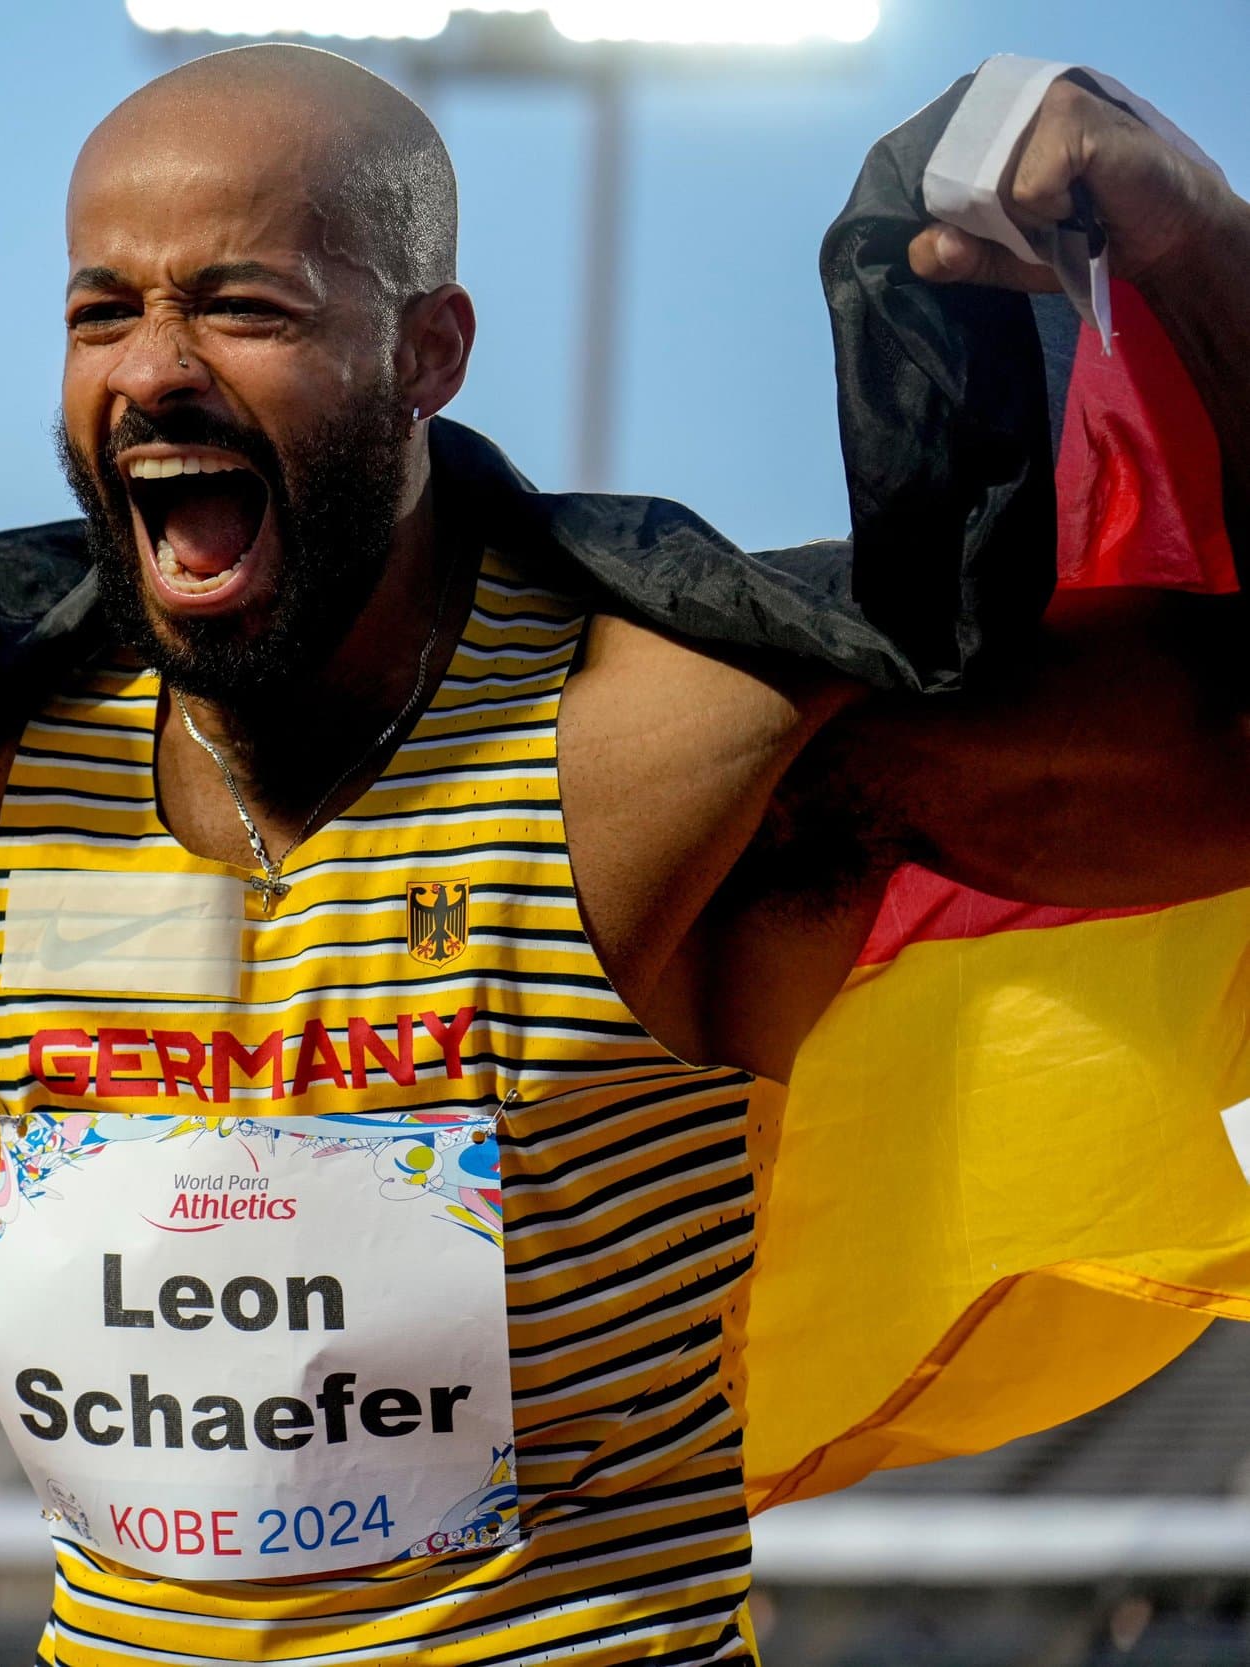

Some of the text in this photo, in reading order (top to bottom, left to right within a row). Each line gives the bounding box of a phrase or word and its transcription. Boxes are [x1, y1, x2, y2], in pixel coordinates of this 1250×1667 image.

[28, 1006, 478, 1104] GERMANY
[170, 1193, 297, 1220] Athletics
[174, 1173, 270, 1191] World Para
[103, 1253, 345, 1331] Leon
[15, 1367, 472, 1451] Schaefer
[110, 1495, 395, 1556] KOBE 2024
